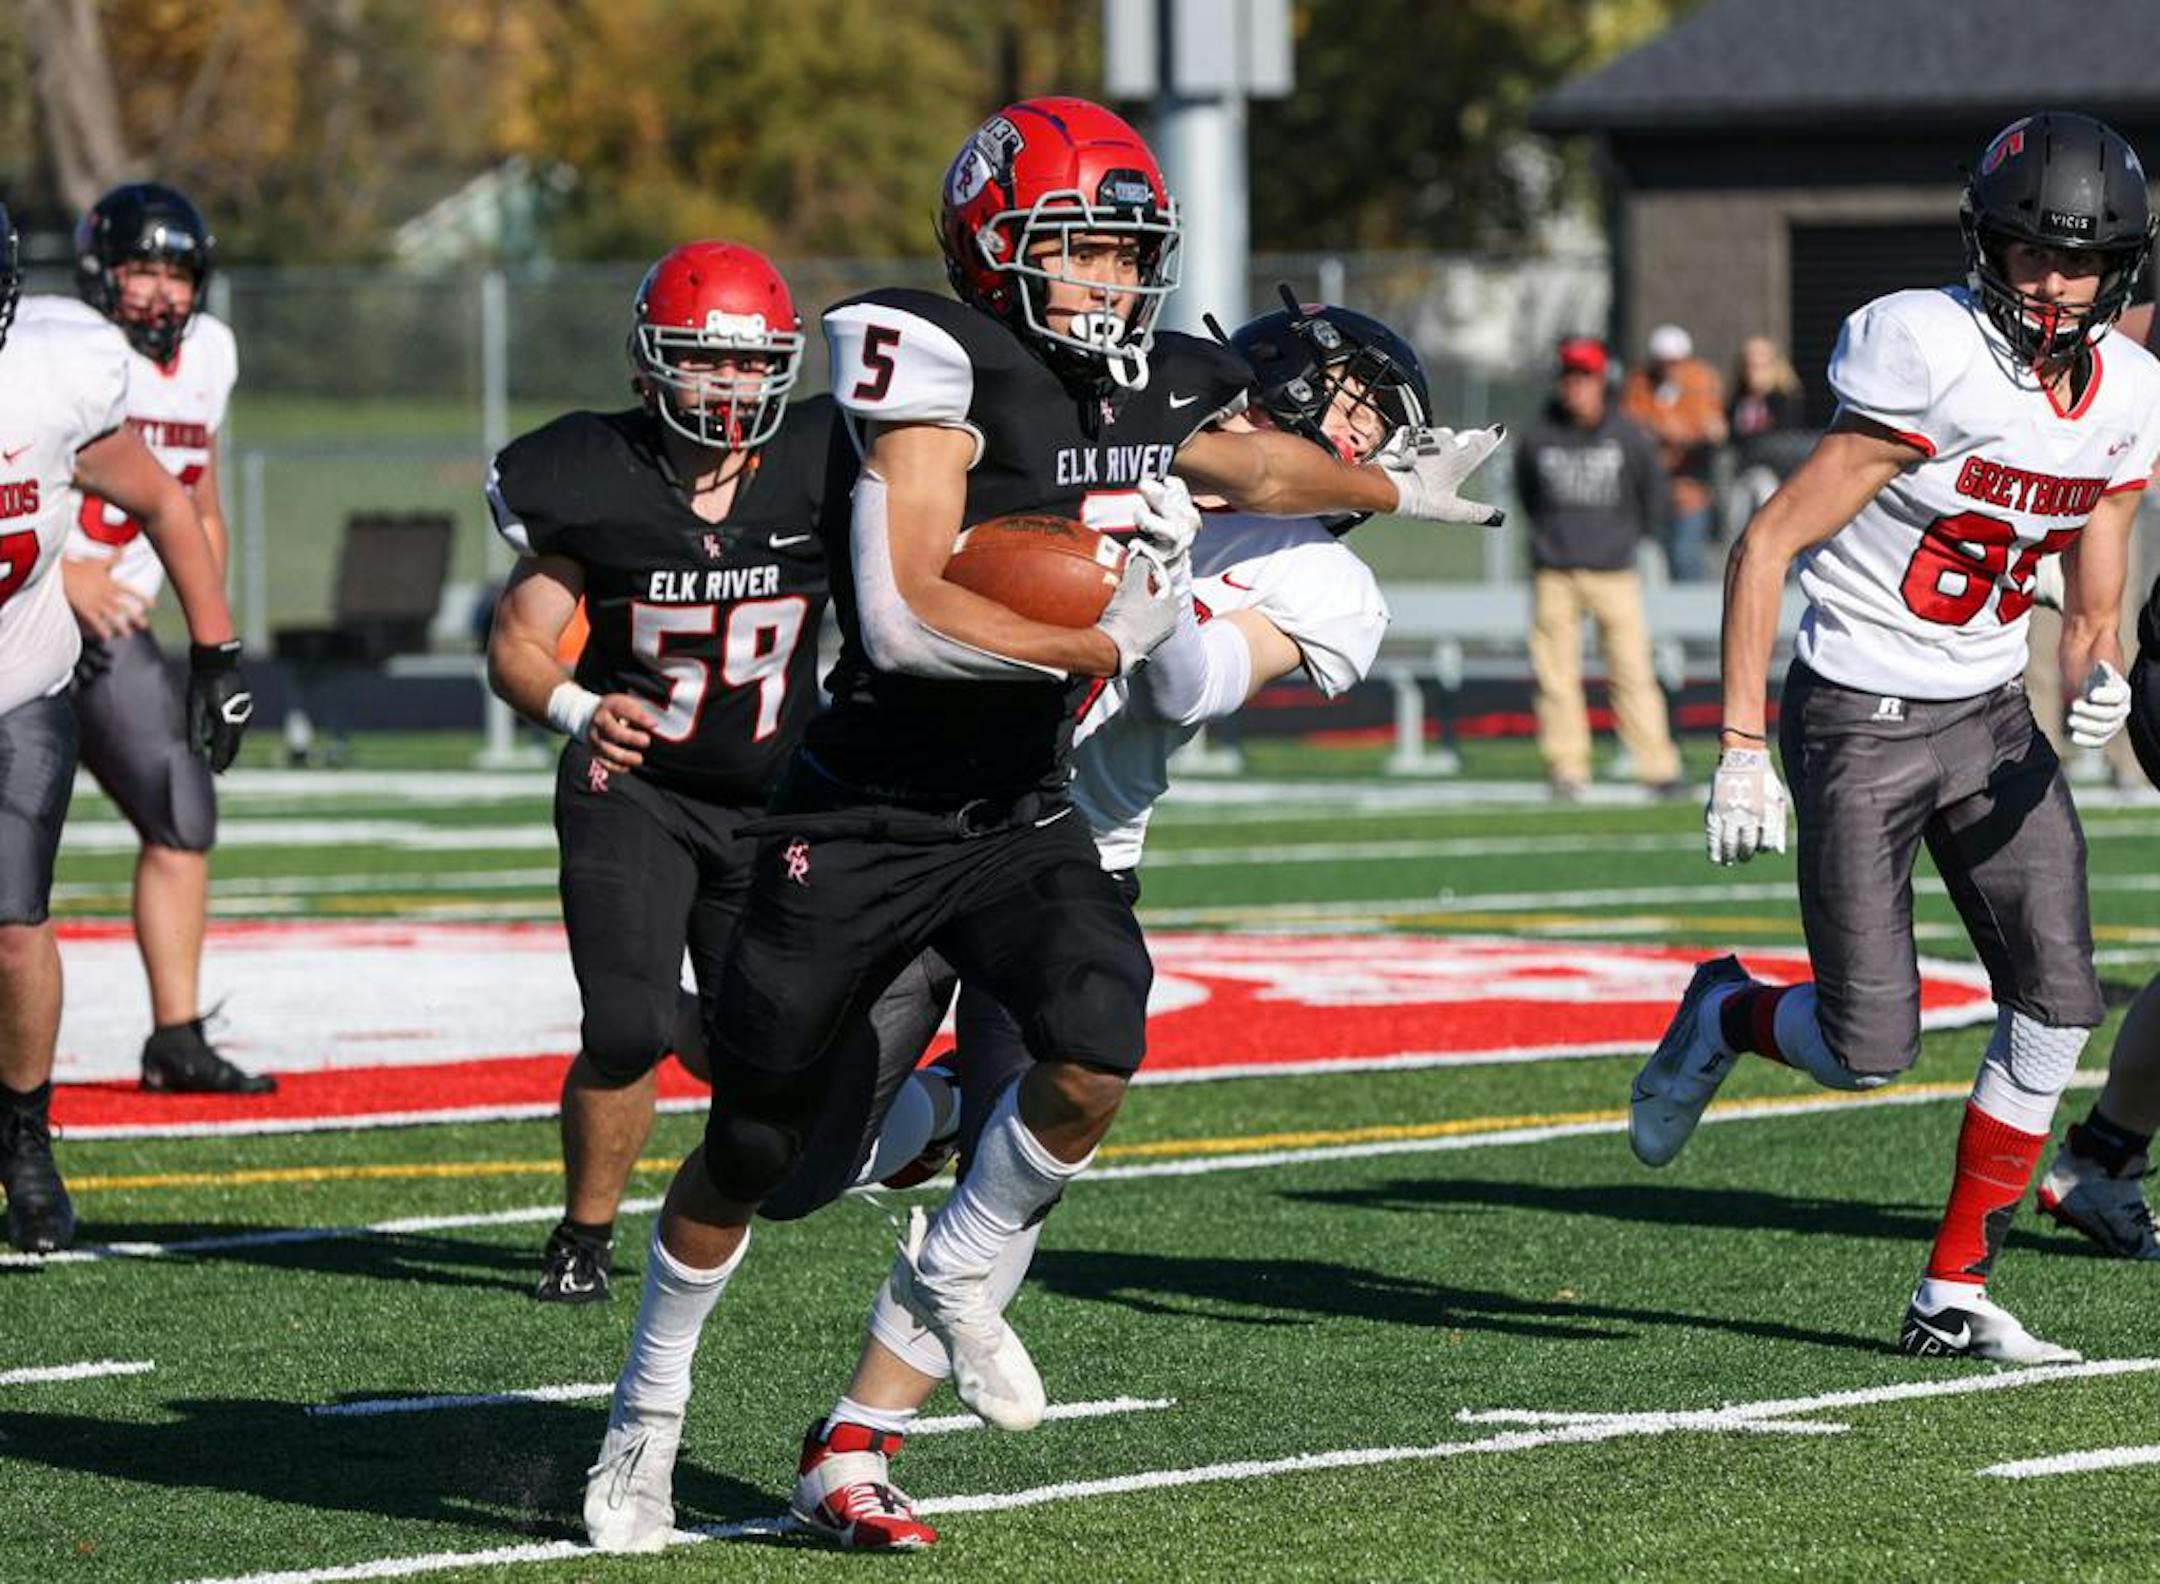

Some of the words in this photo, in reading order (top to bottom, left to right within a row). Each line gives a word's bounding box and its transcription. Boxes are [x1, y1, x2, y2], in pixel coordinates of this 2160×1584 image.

[2051, 213, 2089, 229] VICIS
[852, 324, 901, 402] 5
[1056, 447, 1099, 486] ELK
[1106, 444, 1174, 482] RIVER
[650, 570, 699, 601] ELK
[705, 564, 780, 600] RIVER
[630, 595, 810, 743] 59
